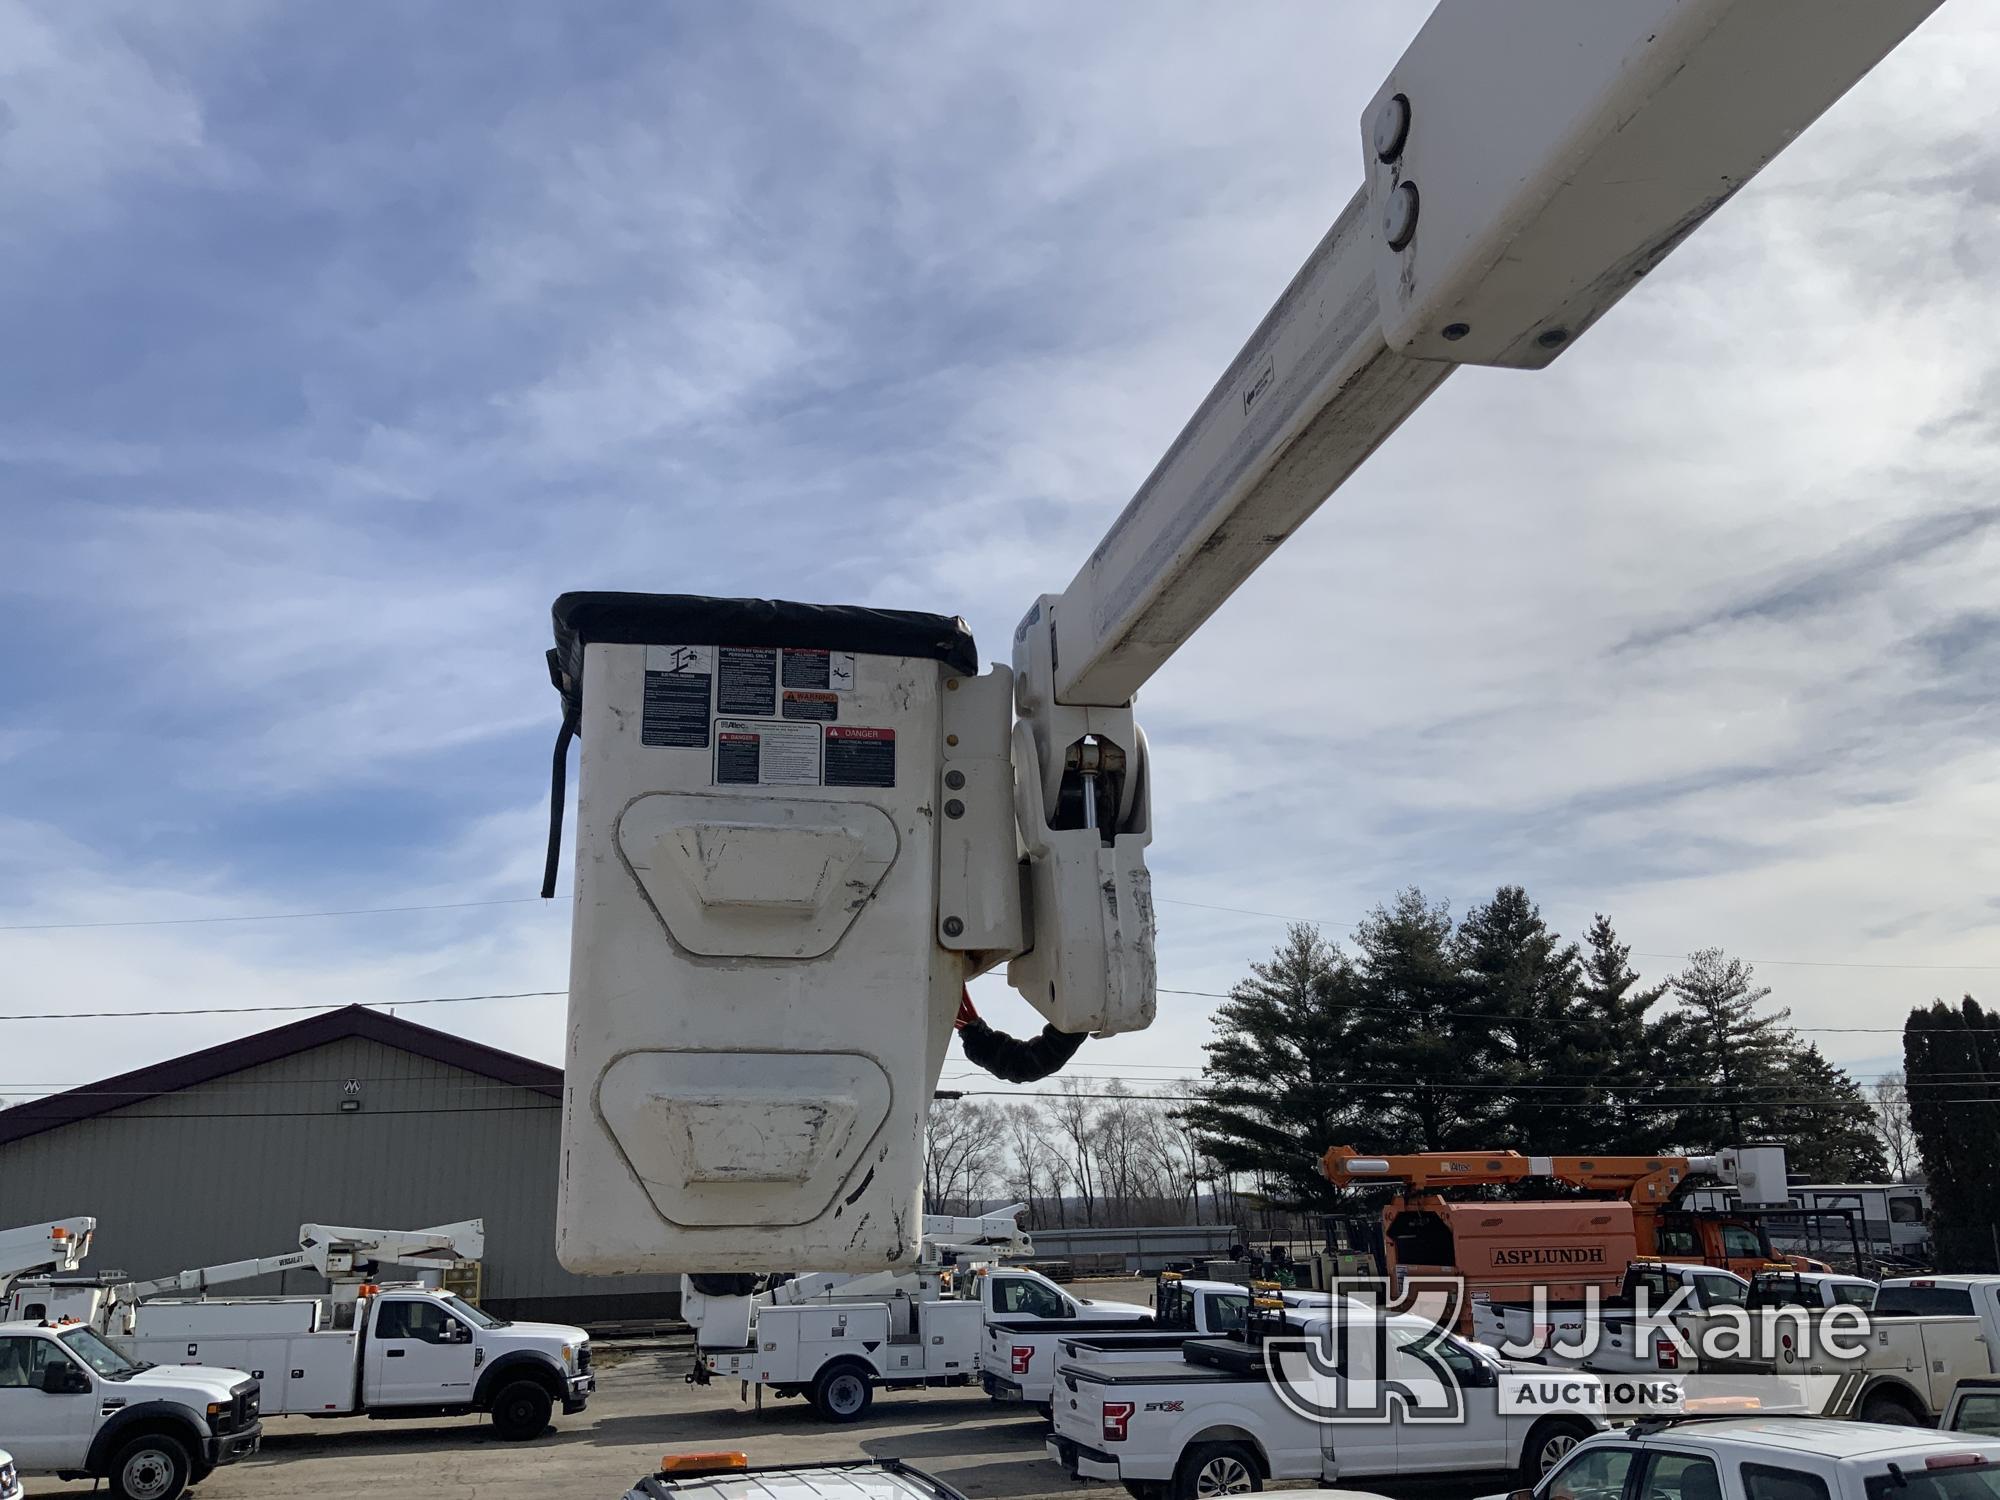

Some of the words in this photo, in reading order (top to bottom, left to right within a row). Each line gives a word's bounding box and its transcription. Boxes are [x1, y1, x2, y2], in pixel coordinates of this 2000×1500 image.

[797, 693, 834, 701] WARNING
[845, 729, 879, 738] DANGER
[1494, 1248, 1604, 1265] ASPLUNDH
[1143, 1400, 1185, 1412] STX
